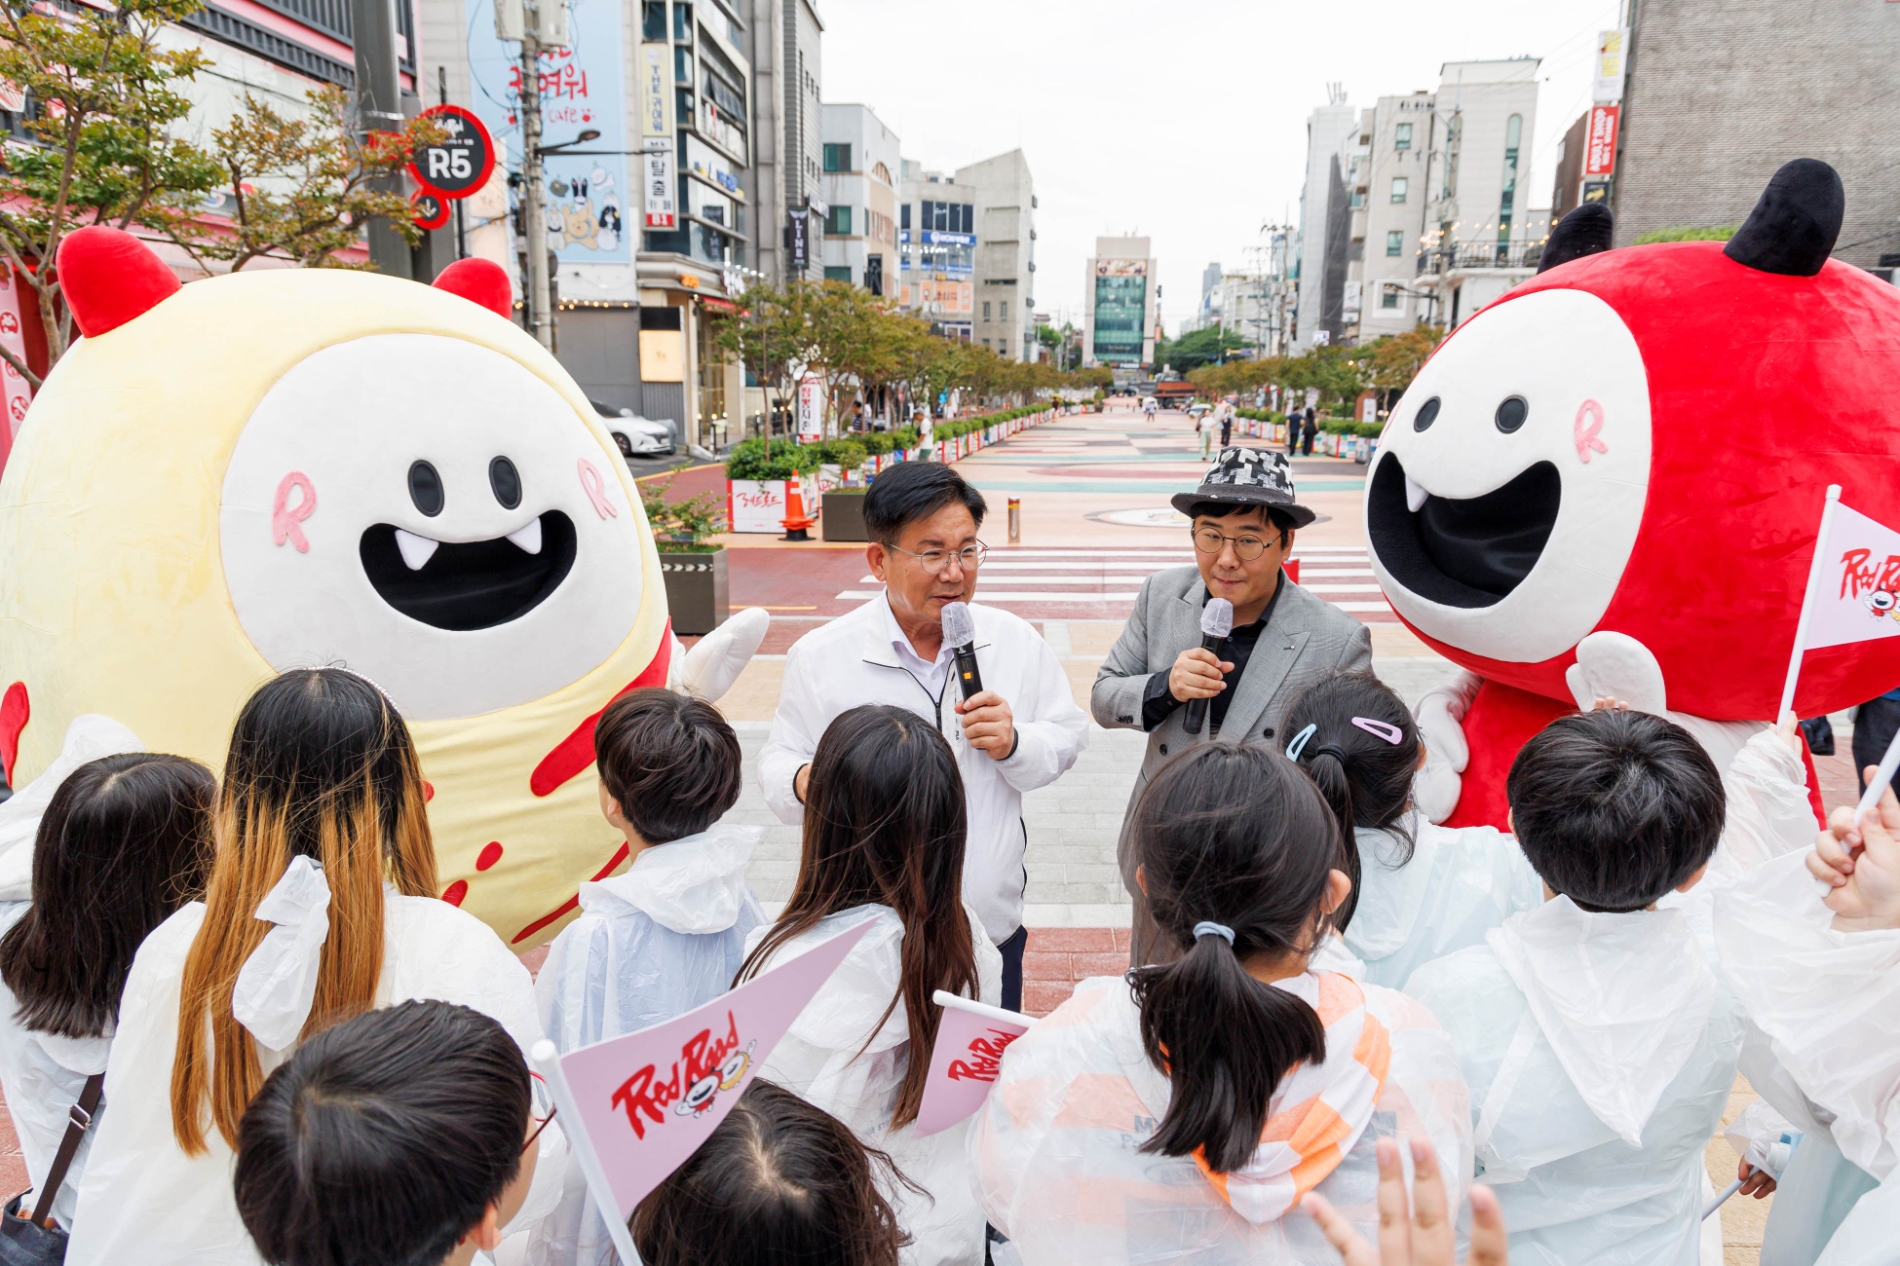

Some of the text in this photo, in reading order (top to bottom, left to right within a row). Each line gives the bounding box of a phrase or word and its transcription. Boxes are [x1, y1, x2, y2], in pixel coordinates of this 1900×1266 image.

[548, 107, 578, 124] cafe
[428, 147, 472, 179] R5
[1588, 137, 1604, 173] ADULT
[795, 219, 804, 258] LINE
[1573, 398, 1609, 464] R
[577, 457, 618, 520] R
[271, 469, 317, 553] R
